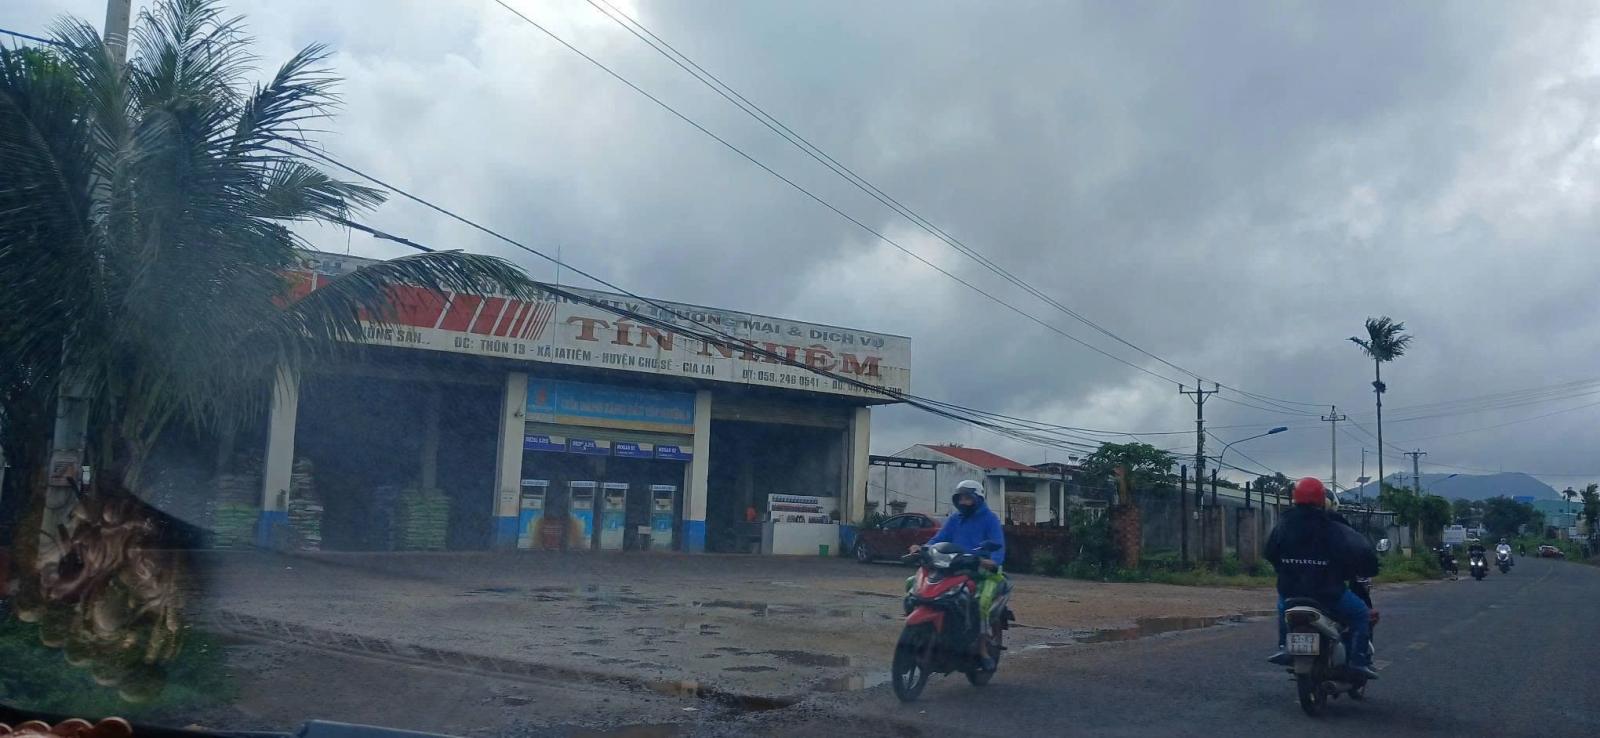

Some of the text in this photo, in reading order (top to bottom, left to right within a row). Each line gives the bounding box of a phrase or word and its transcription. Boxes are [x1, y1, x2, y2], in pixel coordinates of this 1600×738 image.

[788, 325, 802, 338] &
[809, 328, 855, 345] DỊCH
[701, 364, 715, 376] LAI
